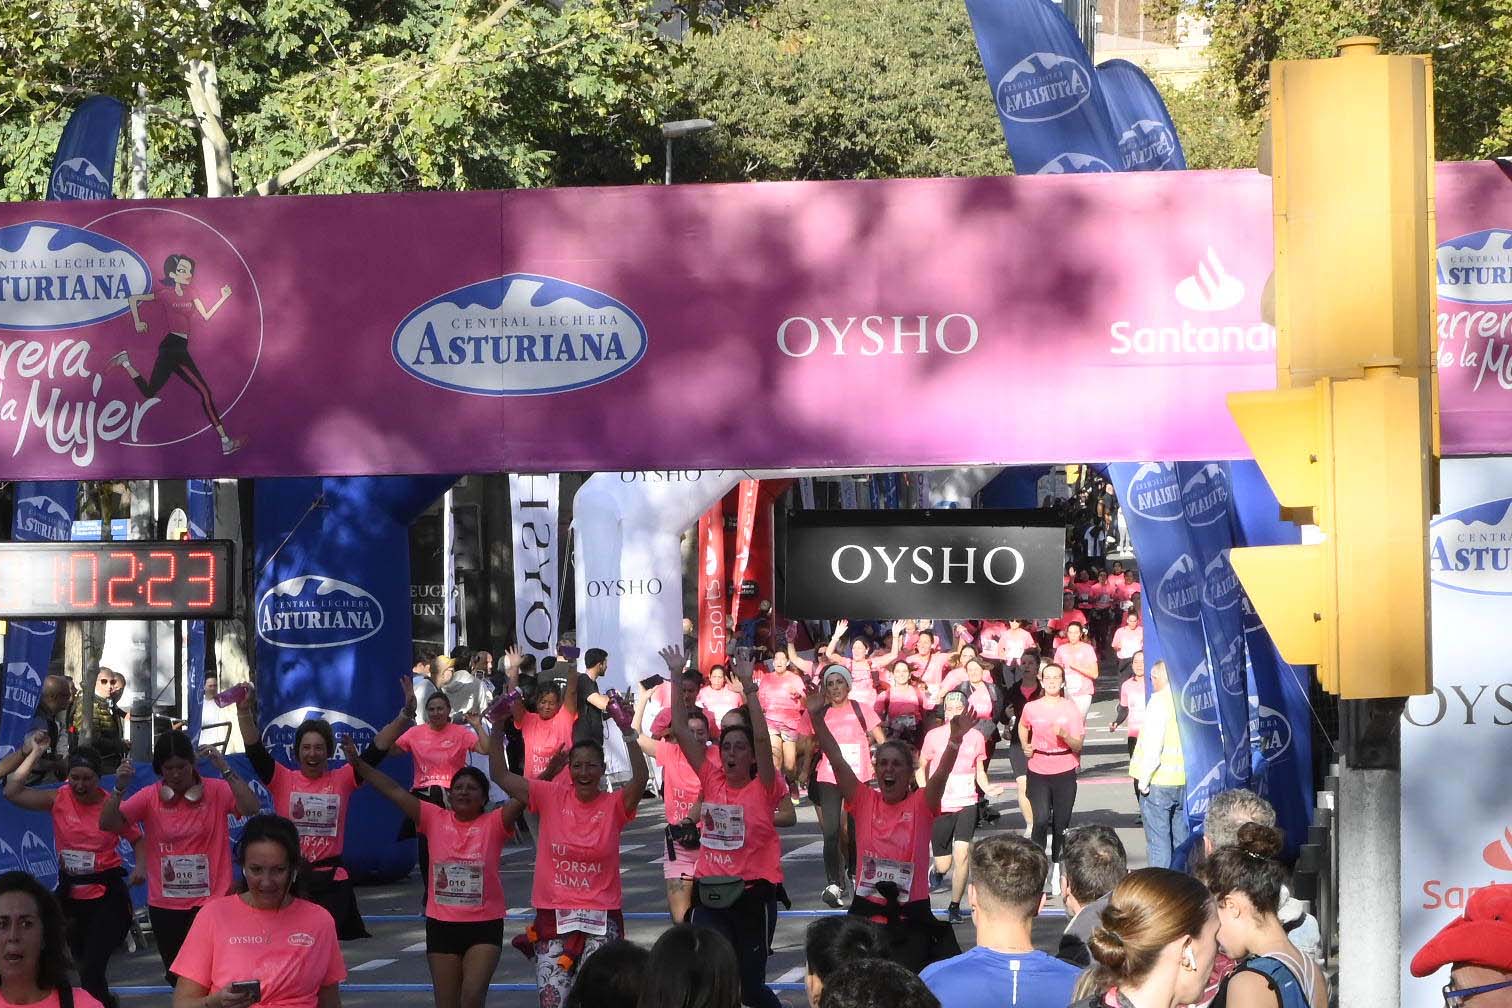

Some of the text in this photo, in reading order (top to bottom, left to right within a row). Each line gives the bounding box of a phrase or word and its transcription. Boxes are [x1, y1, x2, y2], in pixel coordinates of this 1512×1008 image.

[54, 256, 127, 269] LECHERA
[451, 313, 619, 330] CENTRAL LECHERA
[411, 321, 627, 367] ASTURIANA
[776, 312, 979, 358] OYSHO
[12, 373, 162, 467] Mujer
[830, 543, 1025, 585] OYSHO
[586, 578, 663, 598] OYSHO
[261, 606, 374, 632] ASTURIANA
[552, 843, 566, 856] TU
[876, 871, 894, 880] 016
[229, 936, 263, 944] OYSHO
